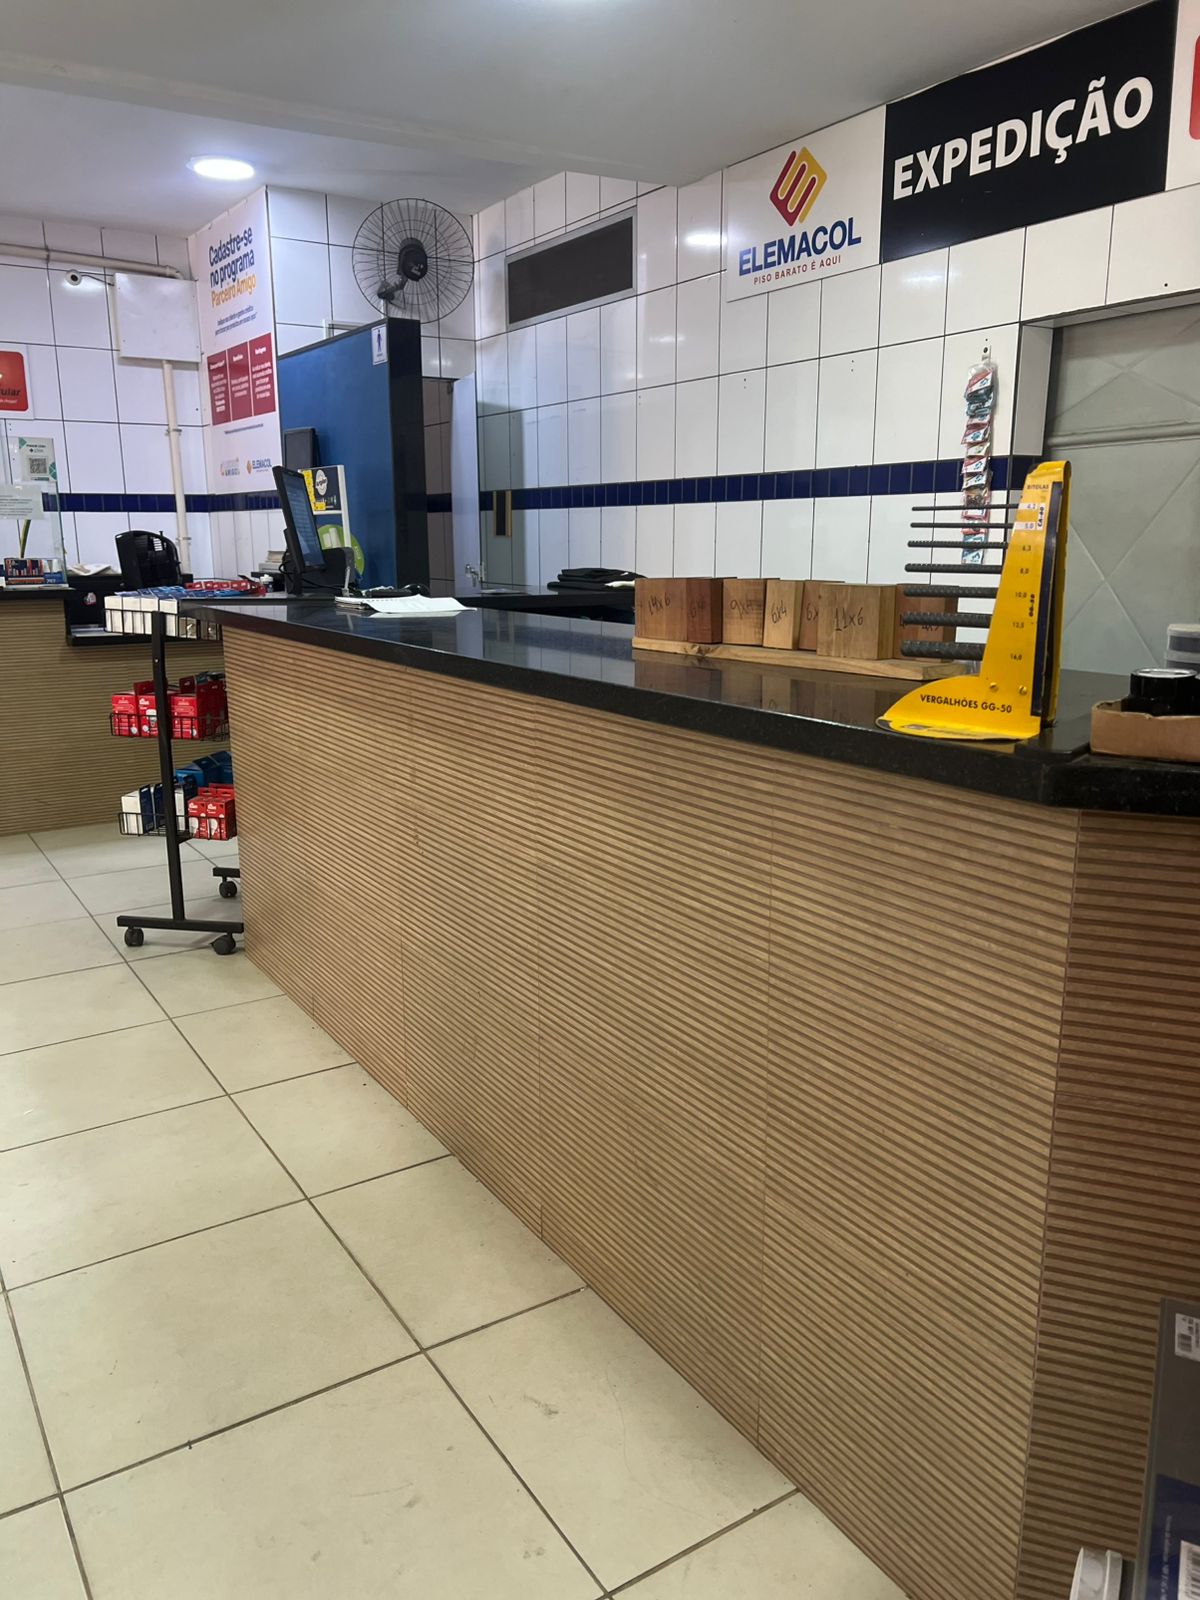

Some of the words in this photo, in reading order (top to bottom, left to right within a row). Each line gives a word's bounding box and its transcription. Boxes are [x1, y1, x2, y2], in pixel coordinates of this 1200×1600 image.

[893, 75, 1154, 201] EXPEDIÇÃO
[208, 227, 253, 267] Cadastre-se
[739, 217, 862, 277] ELEMACOL
[210, 271, 220, 288] no
[219, 249, 255, 289] programa
[753, 273, 772, 285] PISO
[775, 263, 808, 280] BARATO
[810, 260, 817, 271] É
[819, 254, 842, 269] AQUI
[211, 282, 236, 308] Parceiro
[236, 272, 257, 296] Amigo
[0, 387, 21, 397] ular
[834, 606, 864, 632] 11x6
[920, 693, 979, 710] VERGALHÕES
[981, 701, 1013, 714] GG-50
